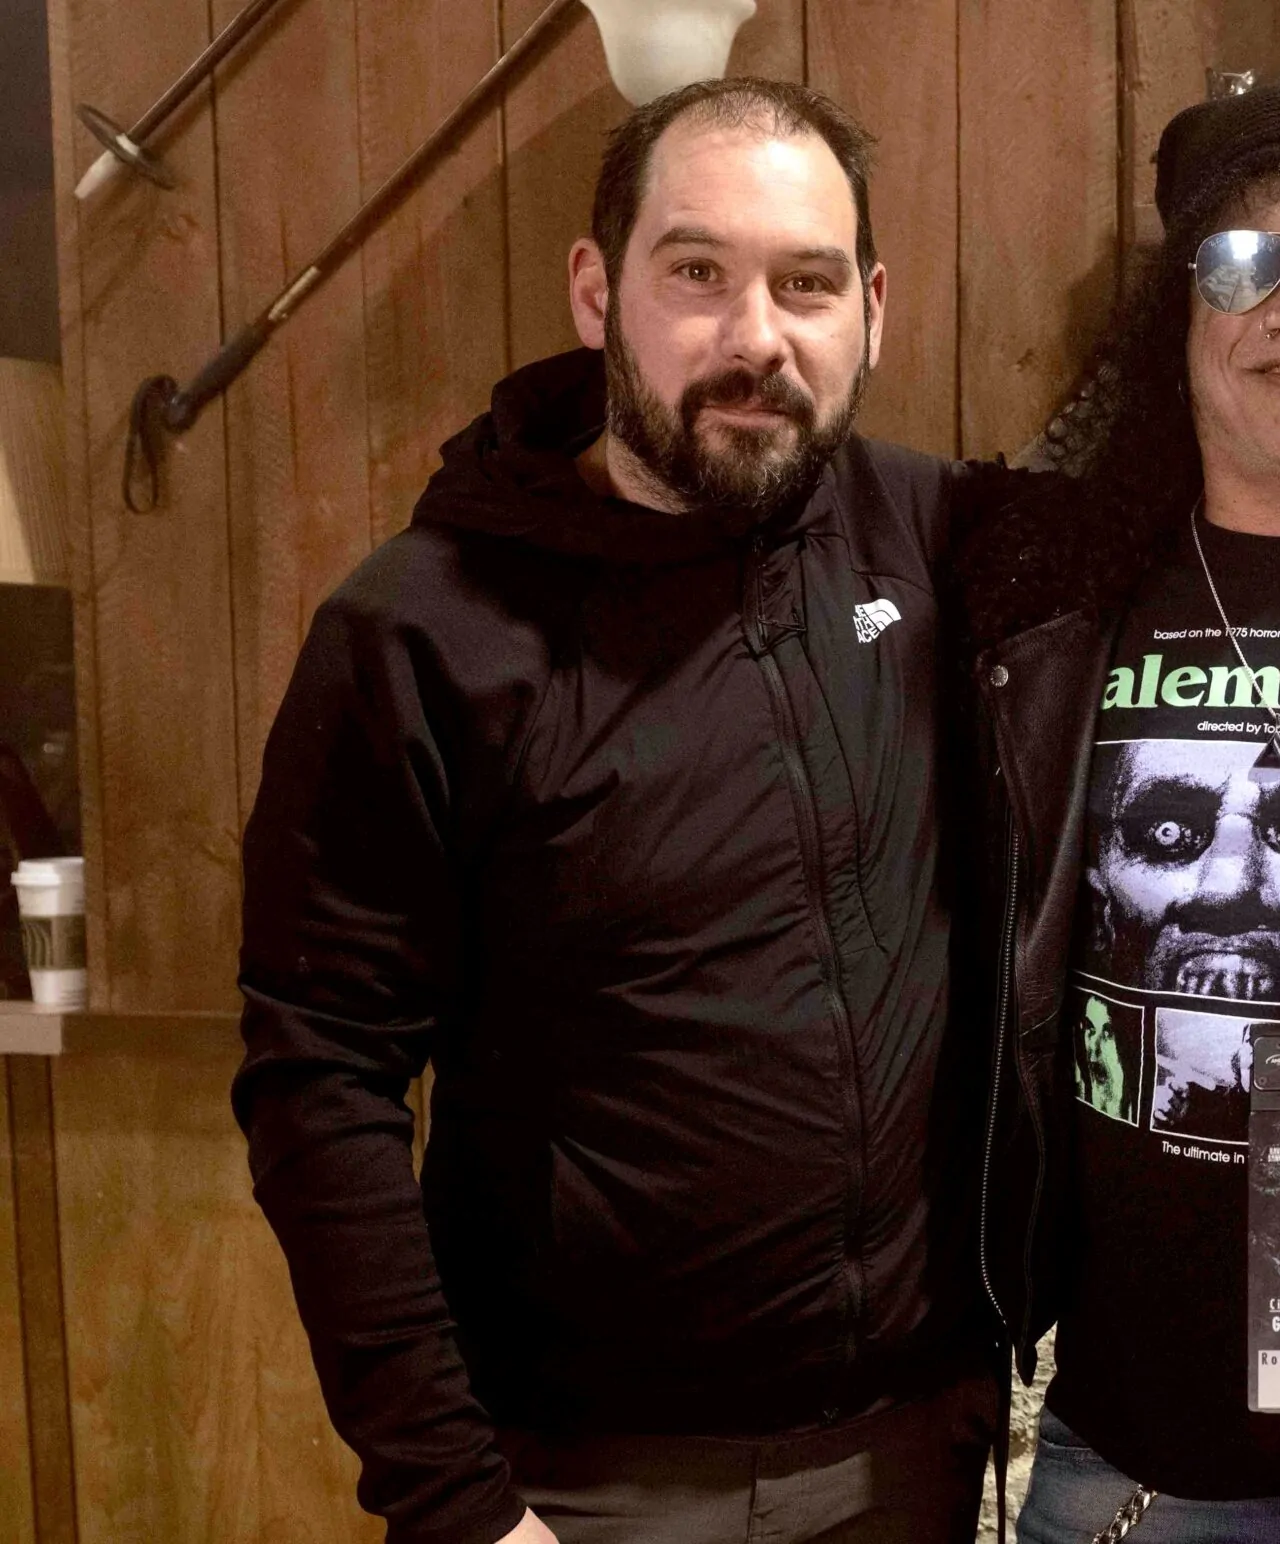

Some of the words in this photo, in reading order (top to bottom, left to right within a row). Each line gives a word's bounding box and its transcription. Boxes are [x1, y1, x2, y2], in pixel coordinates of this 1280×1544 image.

[1153, 629, 1187, 639] based
[1188, 629, 1203, 638] on
[1205, 627, 1222, 637] the
[1225, 627, 1247, 637] 1975
[1249, 627, 1280, 638] horror
[1197, 720, 1244, 732] directed
[1245, 722, 1261, 735] by
[1162, 1140, 1181, 1155] The
[1183, 1145, 1231, 1163] ultimate
[1233, 1151, 1245, 1164] in
